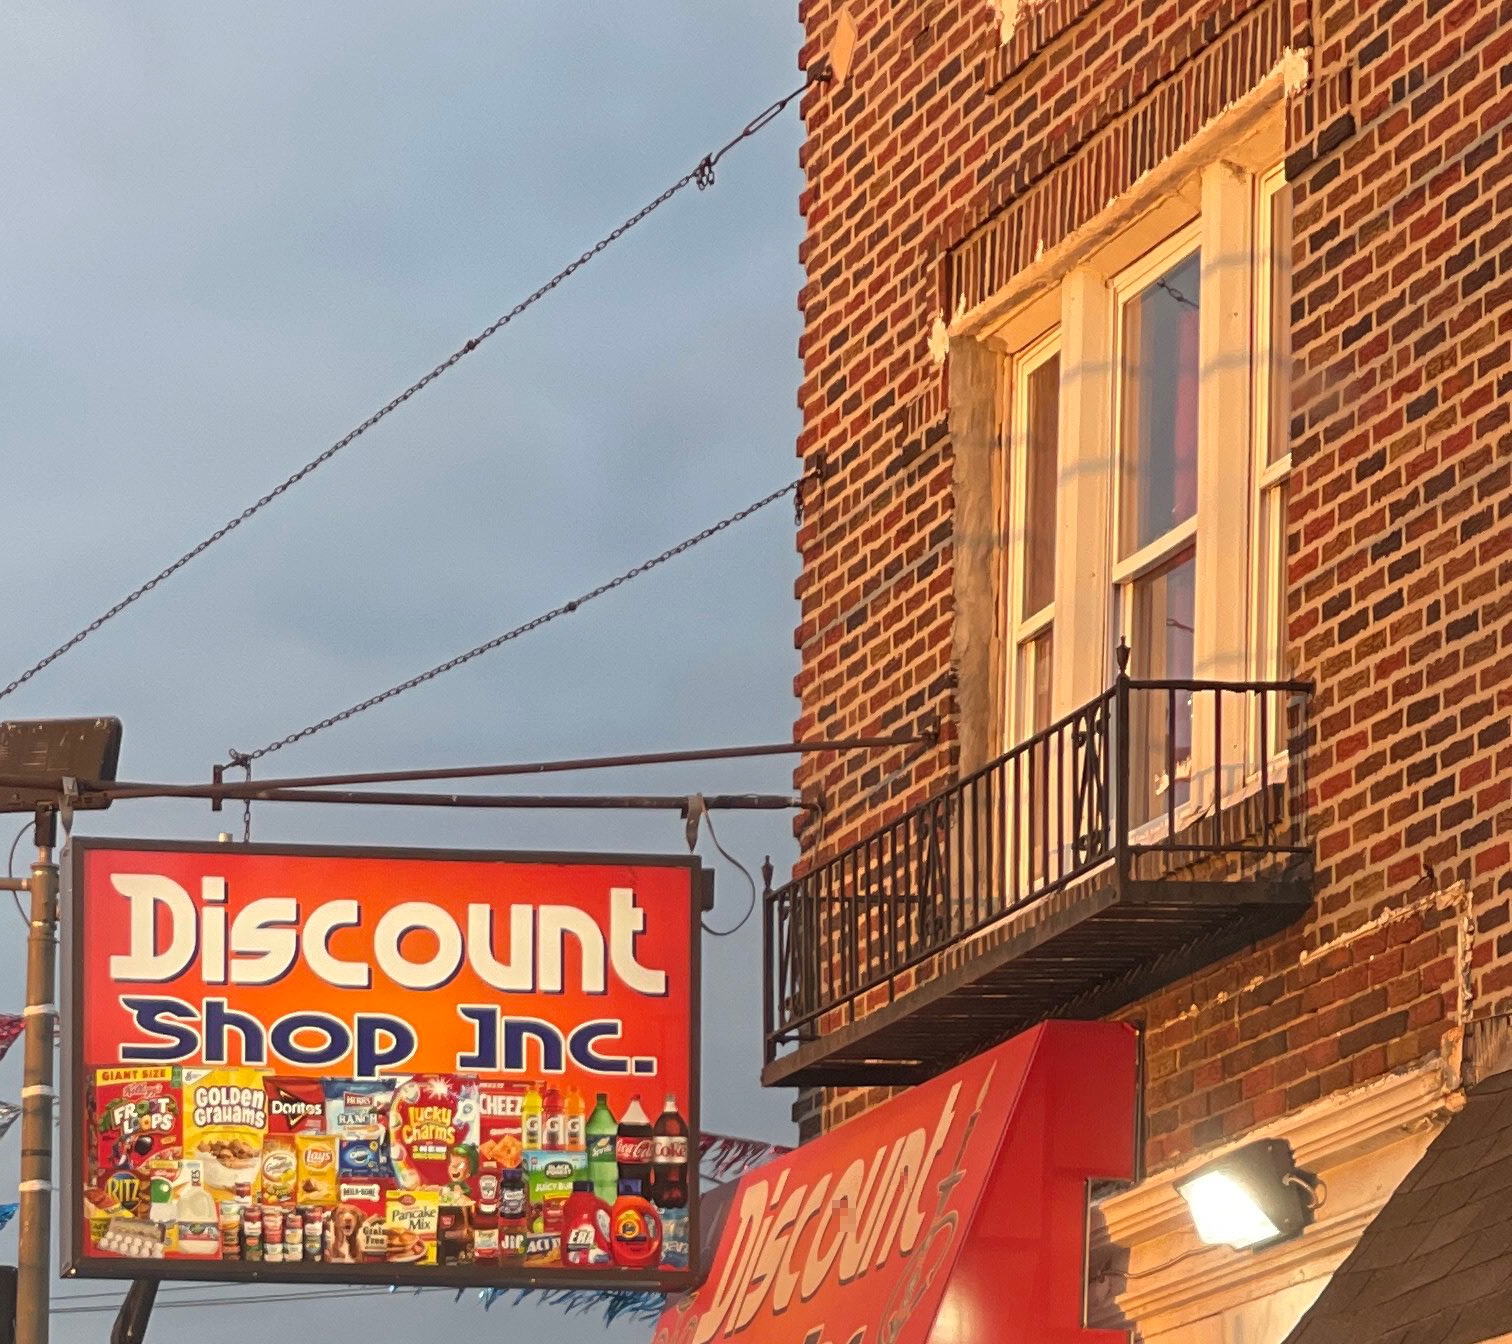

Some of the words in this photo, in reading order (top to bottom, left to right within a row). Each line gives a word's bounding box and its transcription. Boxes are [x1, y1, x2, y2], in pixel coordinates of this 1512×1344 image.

[110, 873, 668, 996] Discount
[118, 995, 418, 1080] Shop
[457, 1003, 657, 1076] Inc.
[102, 1070, 138, 1081] GIANT
[142, 1069, 166, 1079] SIZE
[271, 1100, 322, 1115] Doritos
[107, 1178, 140, 1202] RITZ
[392, 1206, 436, 1222] Pancake
[408, 1219, 431, 1231] Mix
